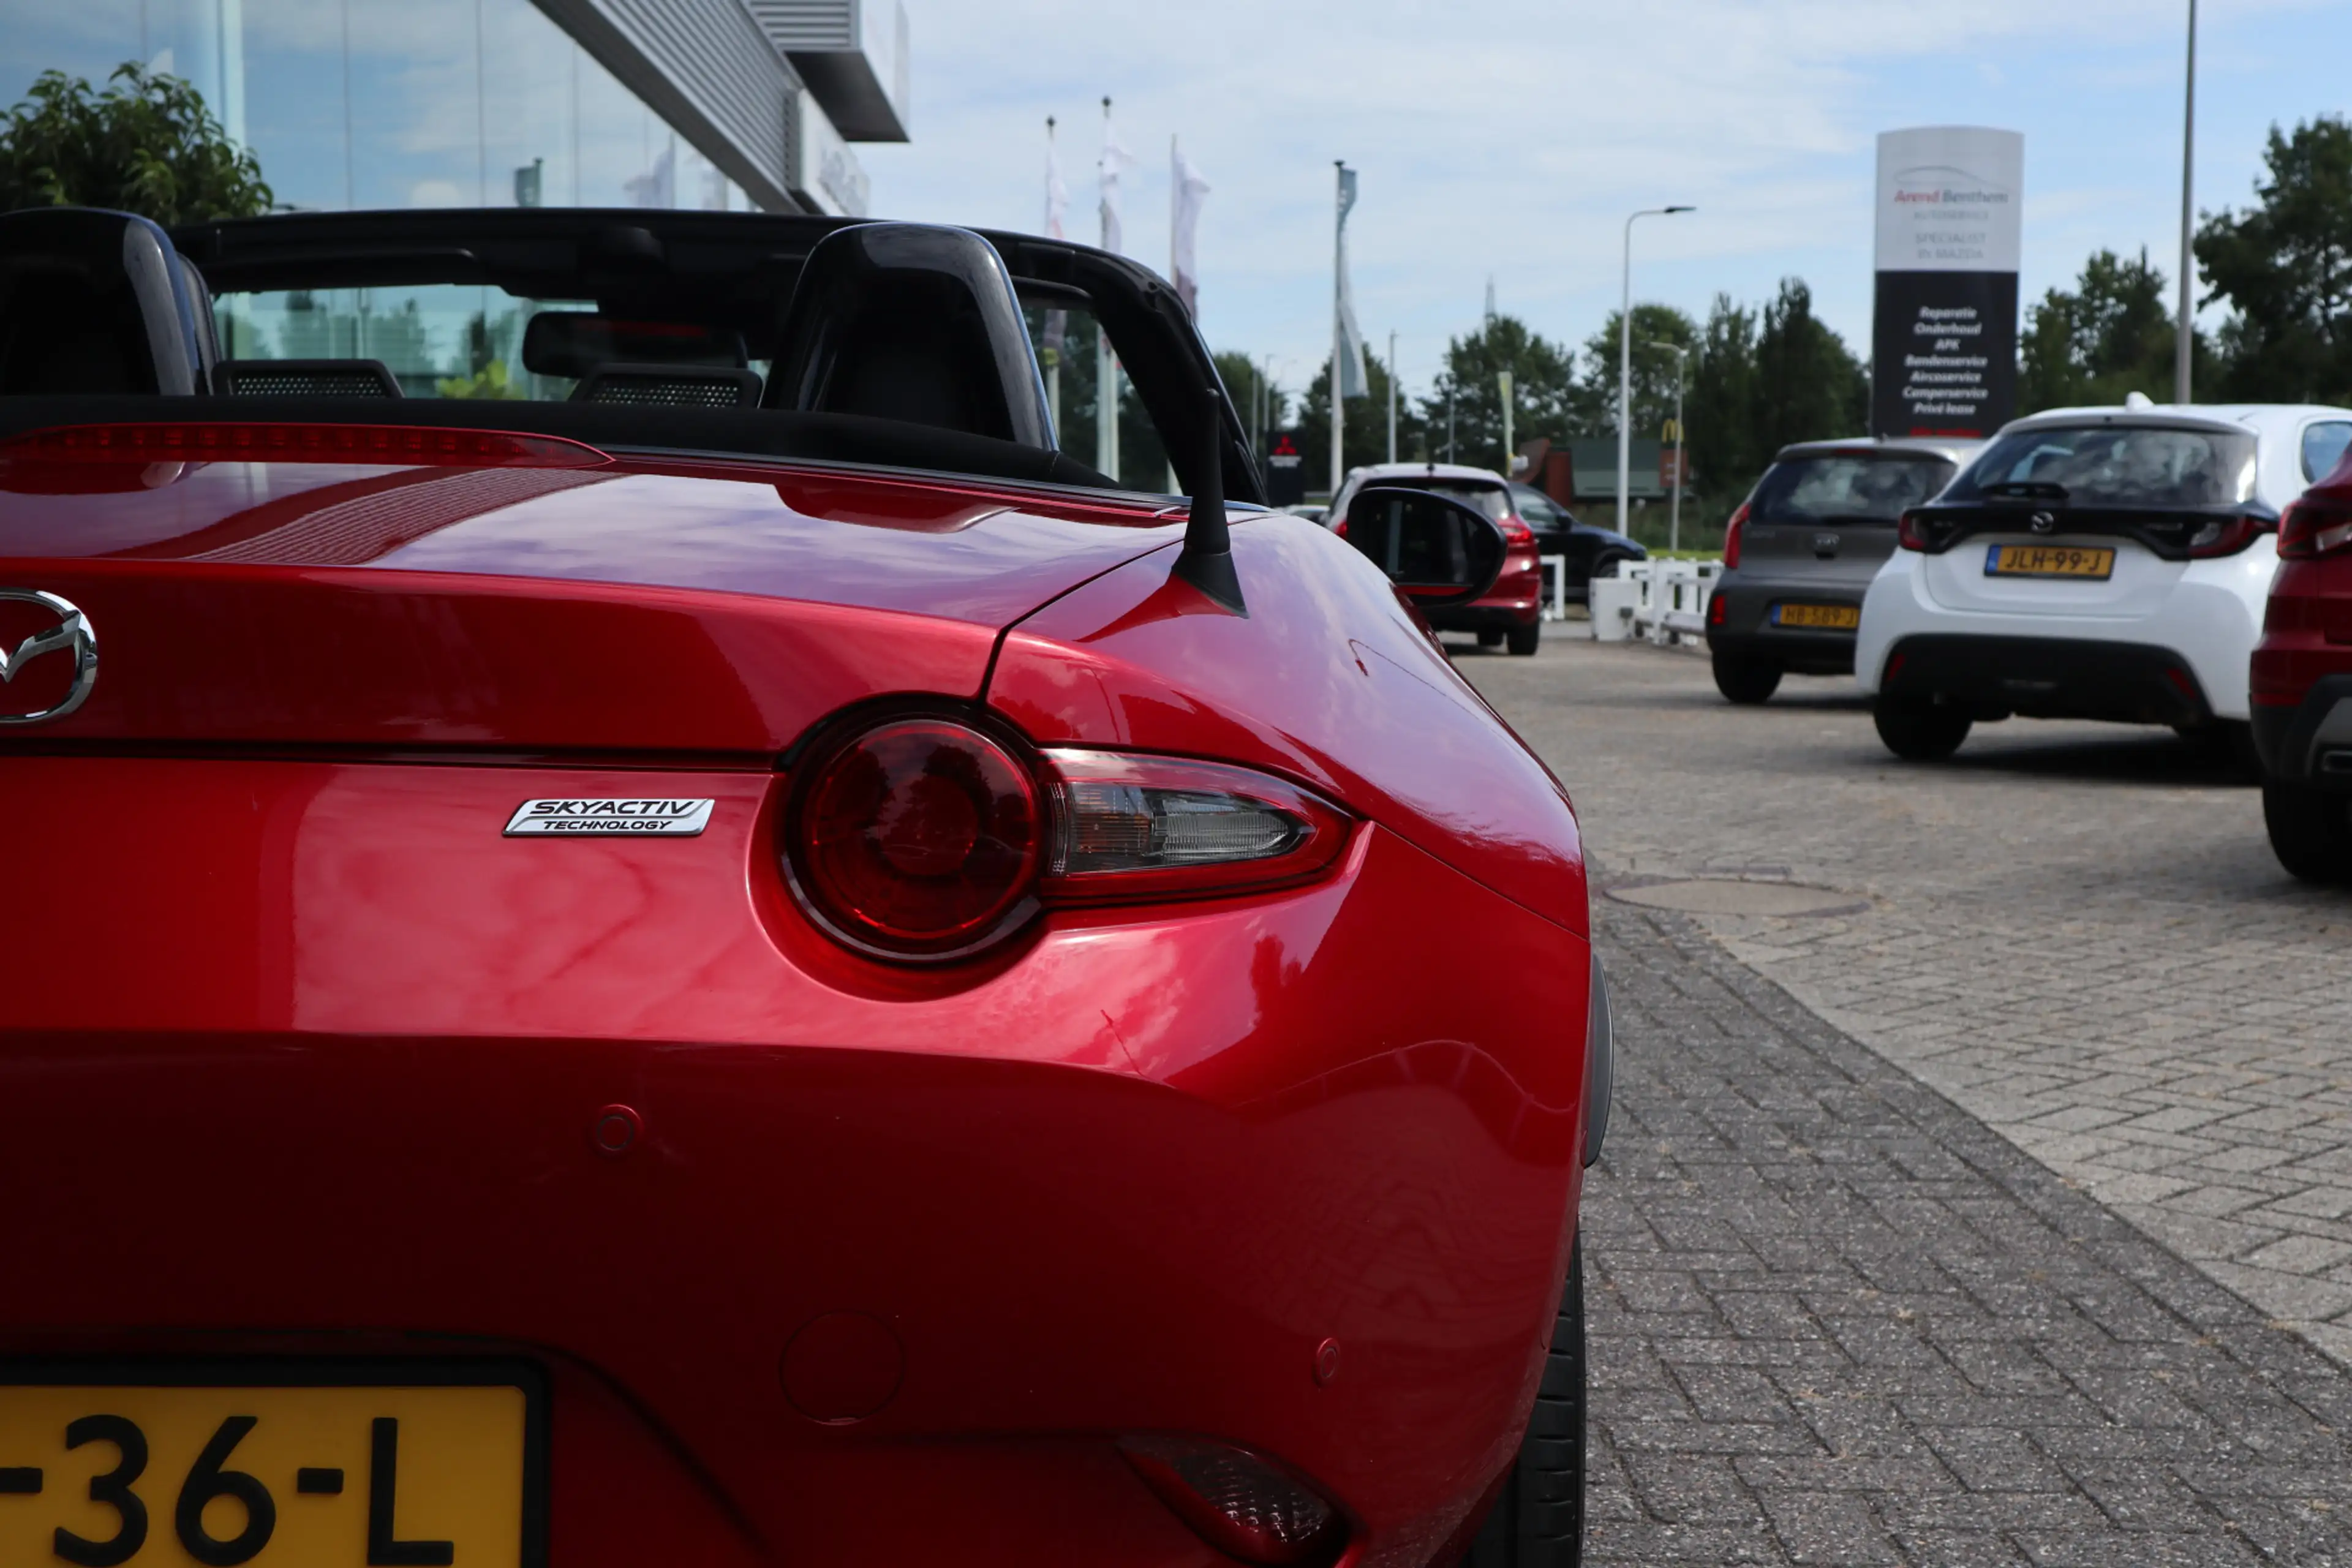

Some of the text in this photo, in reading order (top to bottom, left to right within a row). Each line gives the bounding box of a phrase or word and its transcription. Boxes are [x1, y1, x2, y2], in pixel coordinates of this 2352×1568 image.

[1894, 189, 2009, 204] Arend Benthem
[1915, 232, 1986, 244] SPECIALIST
[1936, 247, 1984, 258] MAZDA
[1919, 306, 1977, 320] Reparatie
[1913, 322, 1982, 336] Onderhoud
[1934, 339, 1961, 351] APK
[1909, 371, 1982, 383] Aircoservice
[1902, 386, 1989, 401] Camperservice
[1946, 402, 1977, 415] lease
[2005, 550, 2101, 572] JLH-99-J
[530, 801, 695, 815] SKYACTIV
[543, 821, 673, 830] TECHNOLOGY
